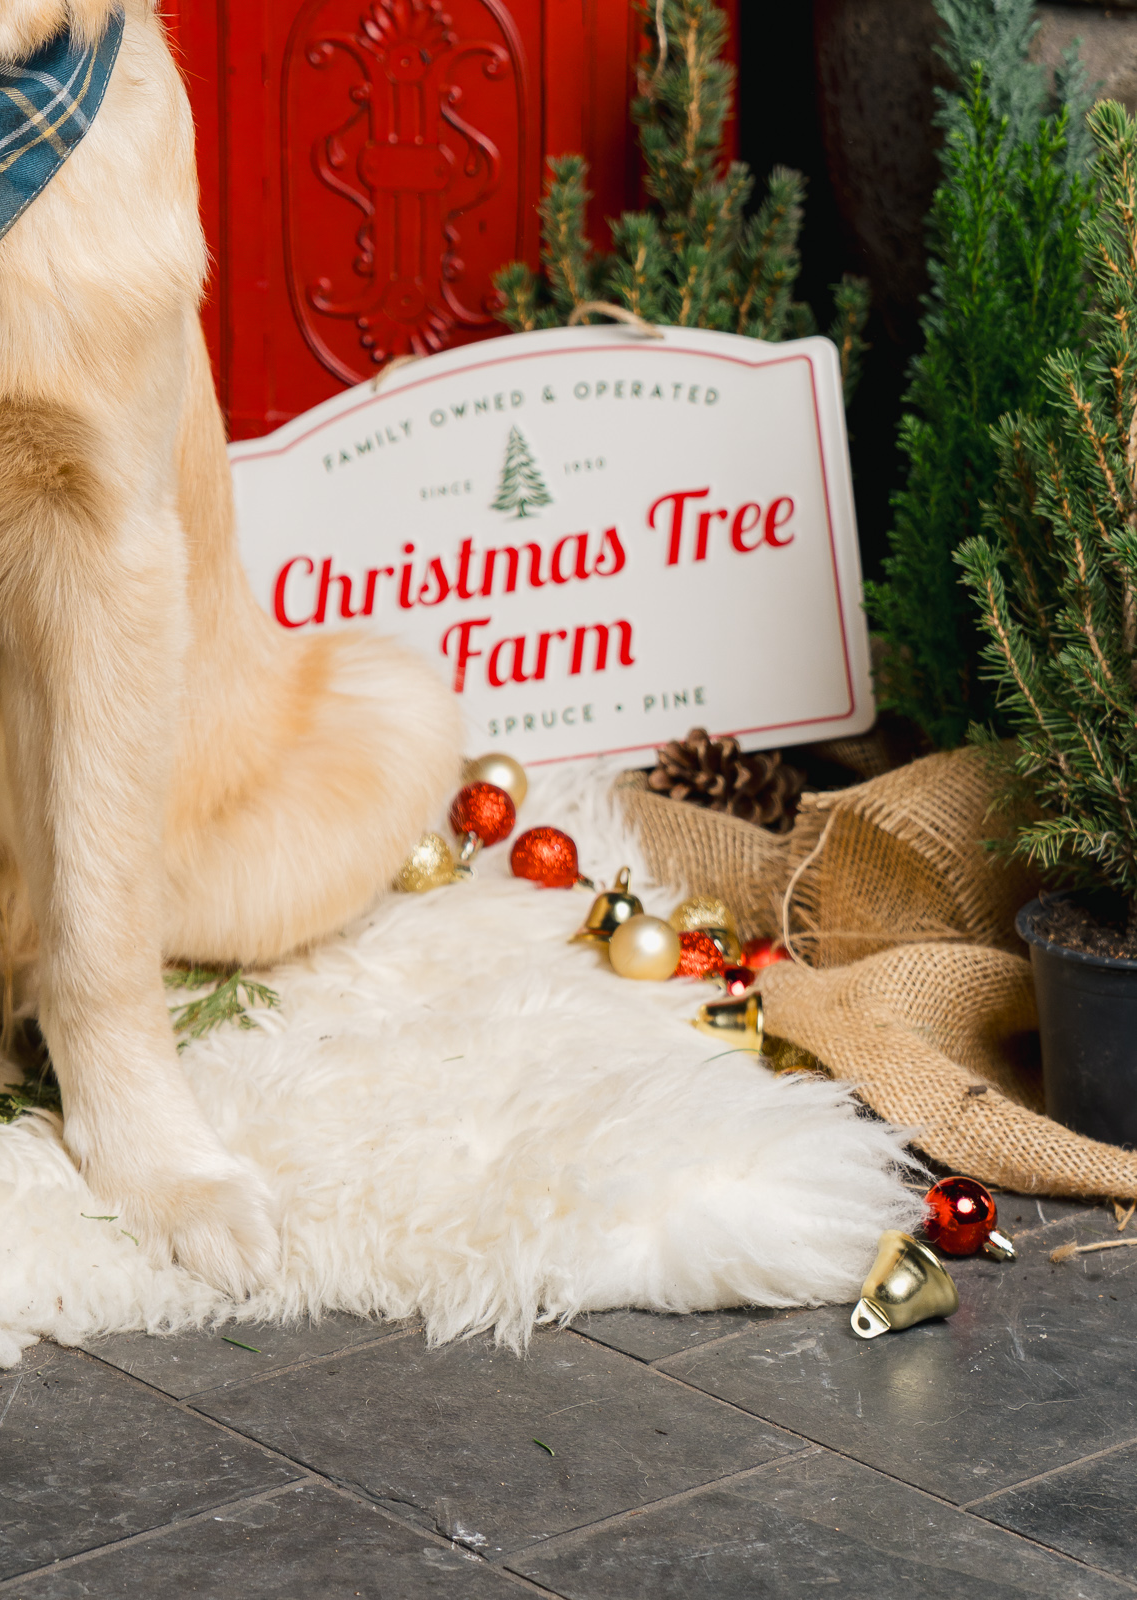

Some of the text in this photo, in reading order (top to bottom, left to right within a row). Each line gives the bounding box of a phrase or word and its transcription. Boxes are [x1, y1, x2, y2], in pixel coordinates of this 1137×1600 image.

[322, 380, 720, 473] FAMILY OWNED & OPERATED
[419, 479, 472, 501] SINCE
[273, 488, 794, 629] Christmas Tree
[441, 618, 634, 693] Farm
[488, 686, 706, 737] SPRUCE PINE
